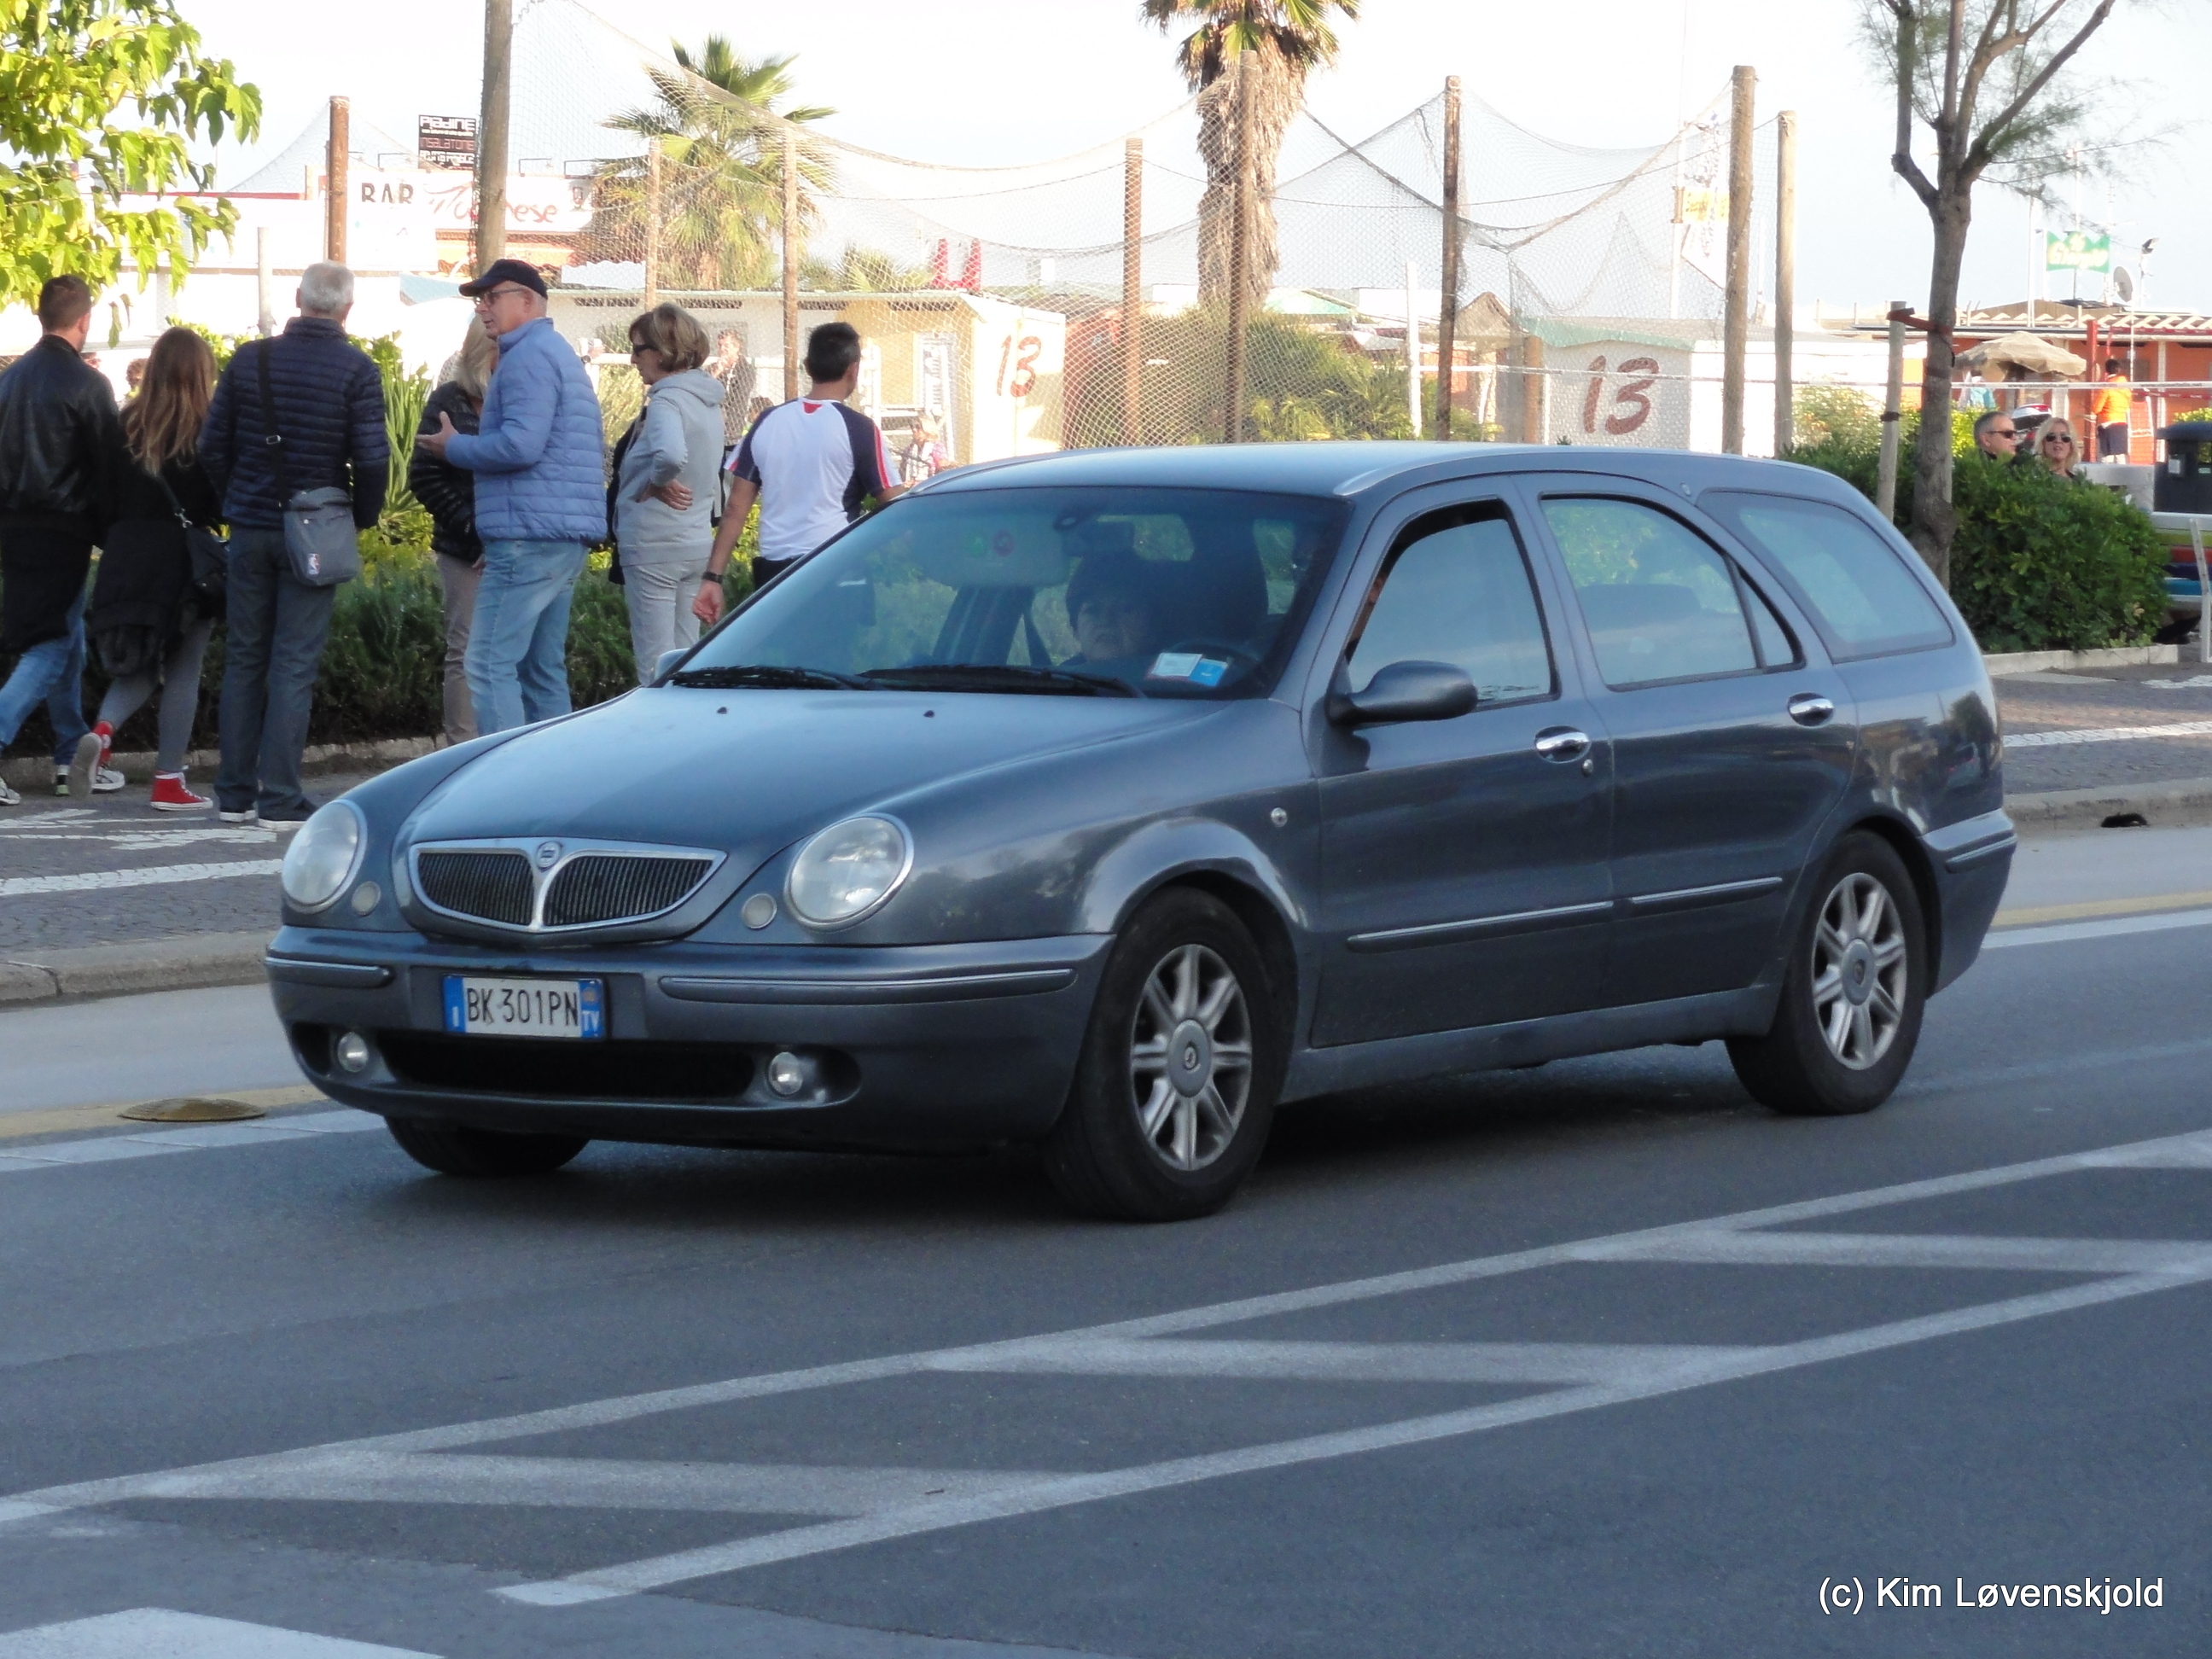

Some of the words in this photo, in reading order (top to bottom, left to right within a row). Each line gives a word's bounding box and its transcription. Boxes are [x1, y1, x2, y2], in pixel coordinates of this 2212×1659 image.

[361, 182, 414, 204] BAR
[997, 335, 1041, 398] 13
[1583, 355, 1659, 435] 13
